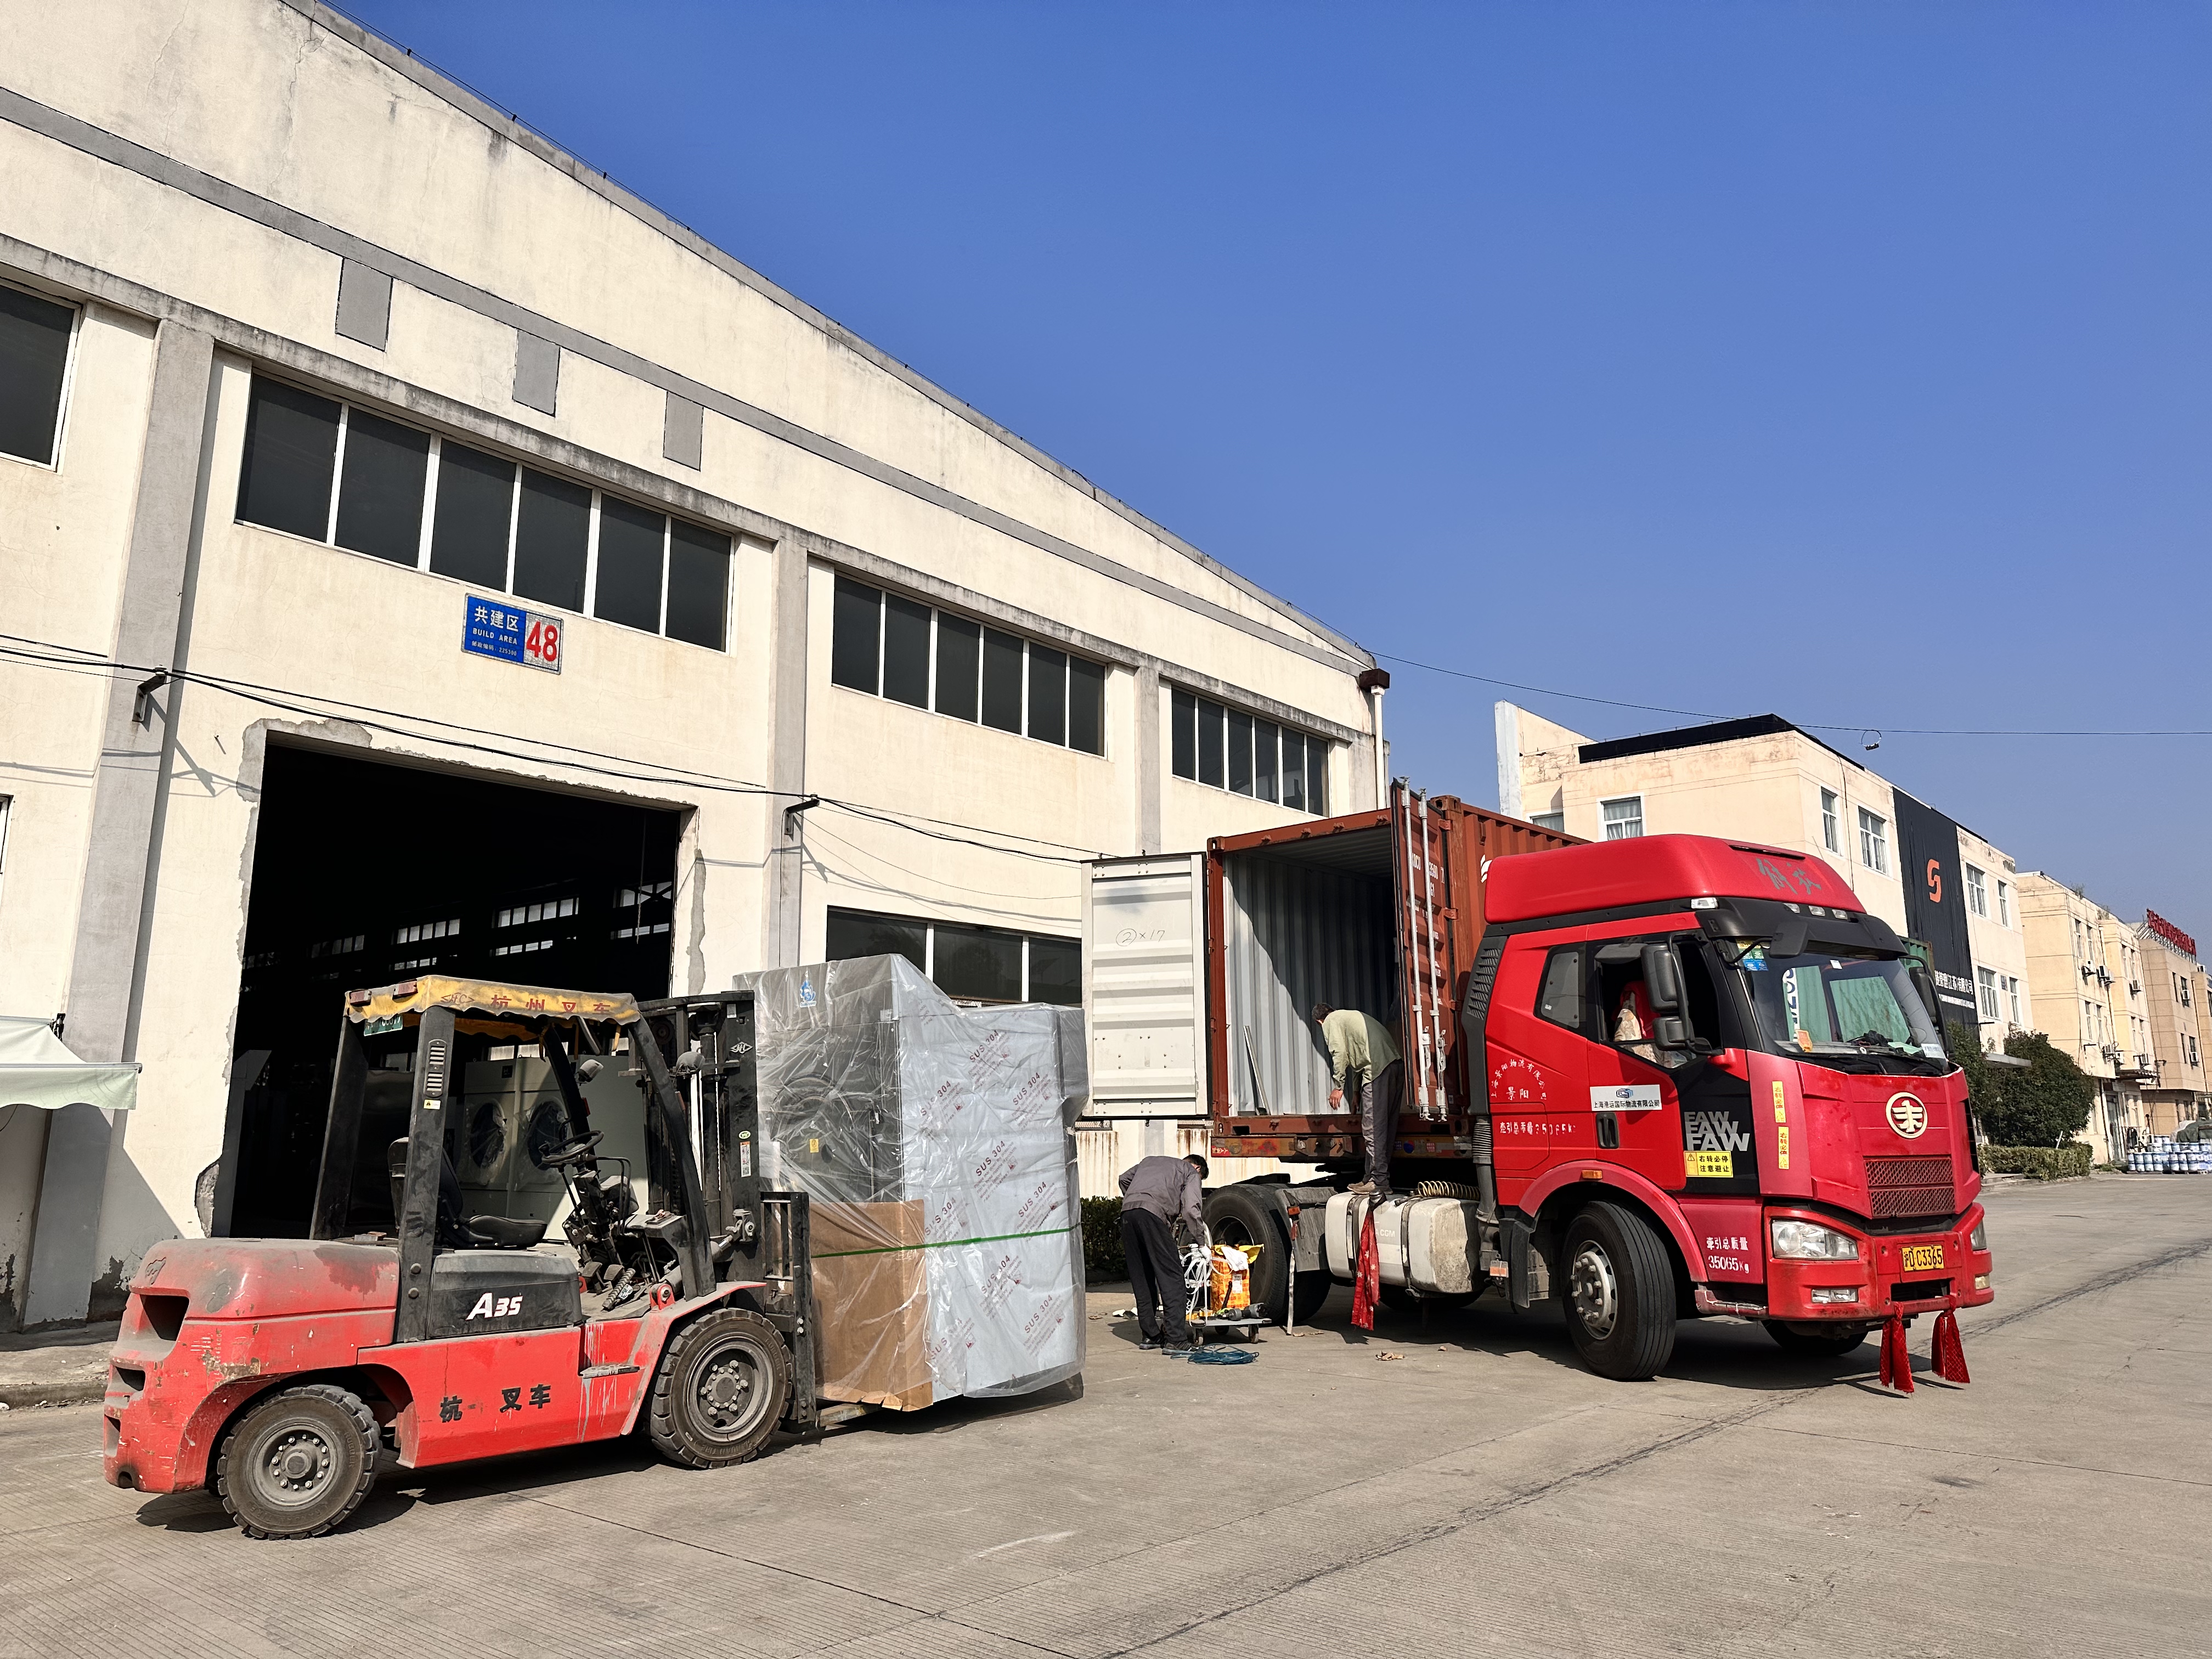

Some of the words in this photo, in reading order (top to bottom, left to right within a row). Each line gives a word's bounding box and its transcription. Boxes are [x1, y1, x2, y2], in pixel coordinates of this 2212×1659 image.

[475, 605, 519, 632] 共建区
[472, 628, 494, 639] BUILD
[499, 634, 518, 645] AREA
[526, 621, 558, 662] 48
[499, 647, 517, 657] 225300
[969, 1044, 984, 1063] SUS
[985, 1029, 998, 1046] 304
[937, 1080, 951, 1097] 304
[1012, 1087, 1027, 1105] SUS
[1027, 1072, 1040, 1088] 304
[1506, 1086, 1530, 1101] 景阳
[1684, 1111, 1729, 1123] FAW
[1685, 1121, 1739, 1136] FAW
[1686, 1133, 1751, 1152] FAW
[975, 1156, 991, 1176] SUS
[991, 1140, 1005, 1157] 304
[941, 1197, 956, 1215] 304
[1017, 1197, 1034, 1217] SUS
[1033, 1181, 1046, 1198] 304
[1380, 1229, 1396, 1238] CGM
[1706, 1237, 1749, 1251] 牵引总质量
[465, 1292, 523, 1321] A35
[1023, 1312, 1040, 1334] SUS
[1039, 1294, 1053, 1312] 304
